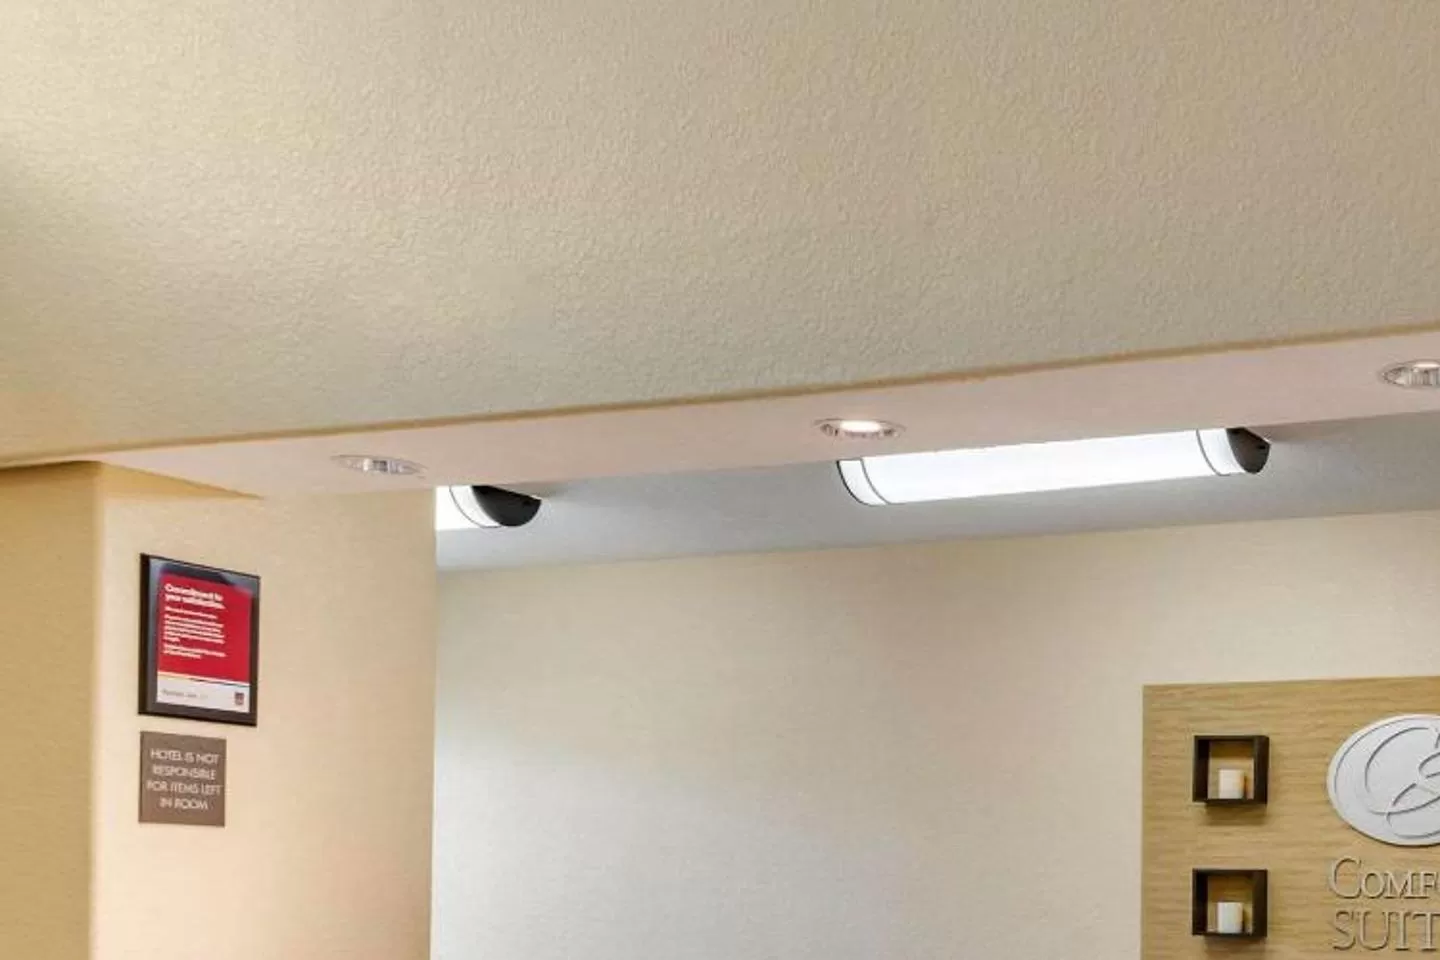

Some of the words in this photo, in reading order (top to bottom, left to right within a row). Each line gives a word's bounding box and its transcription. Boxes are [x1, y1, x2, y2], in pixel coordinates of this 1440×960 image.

[150, 748, 183, 761] HOTEL
[184, 751, 195, 764] IS
[196, 753, 220, 765] NOT
[152, 764, 217, 780] RESPONSIBLE
[146, 779, 168, 792] FOR
[170, 781, 199, 794] ITEMS
[201, 783, 221, 796] LEFT
[174, 797, 209, 810] ROOM
